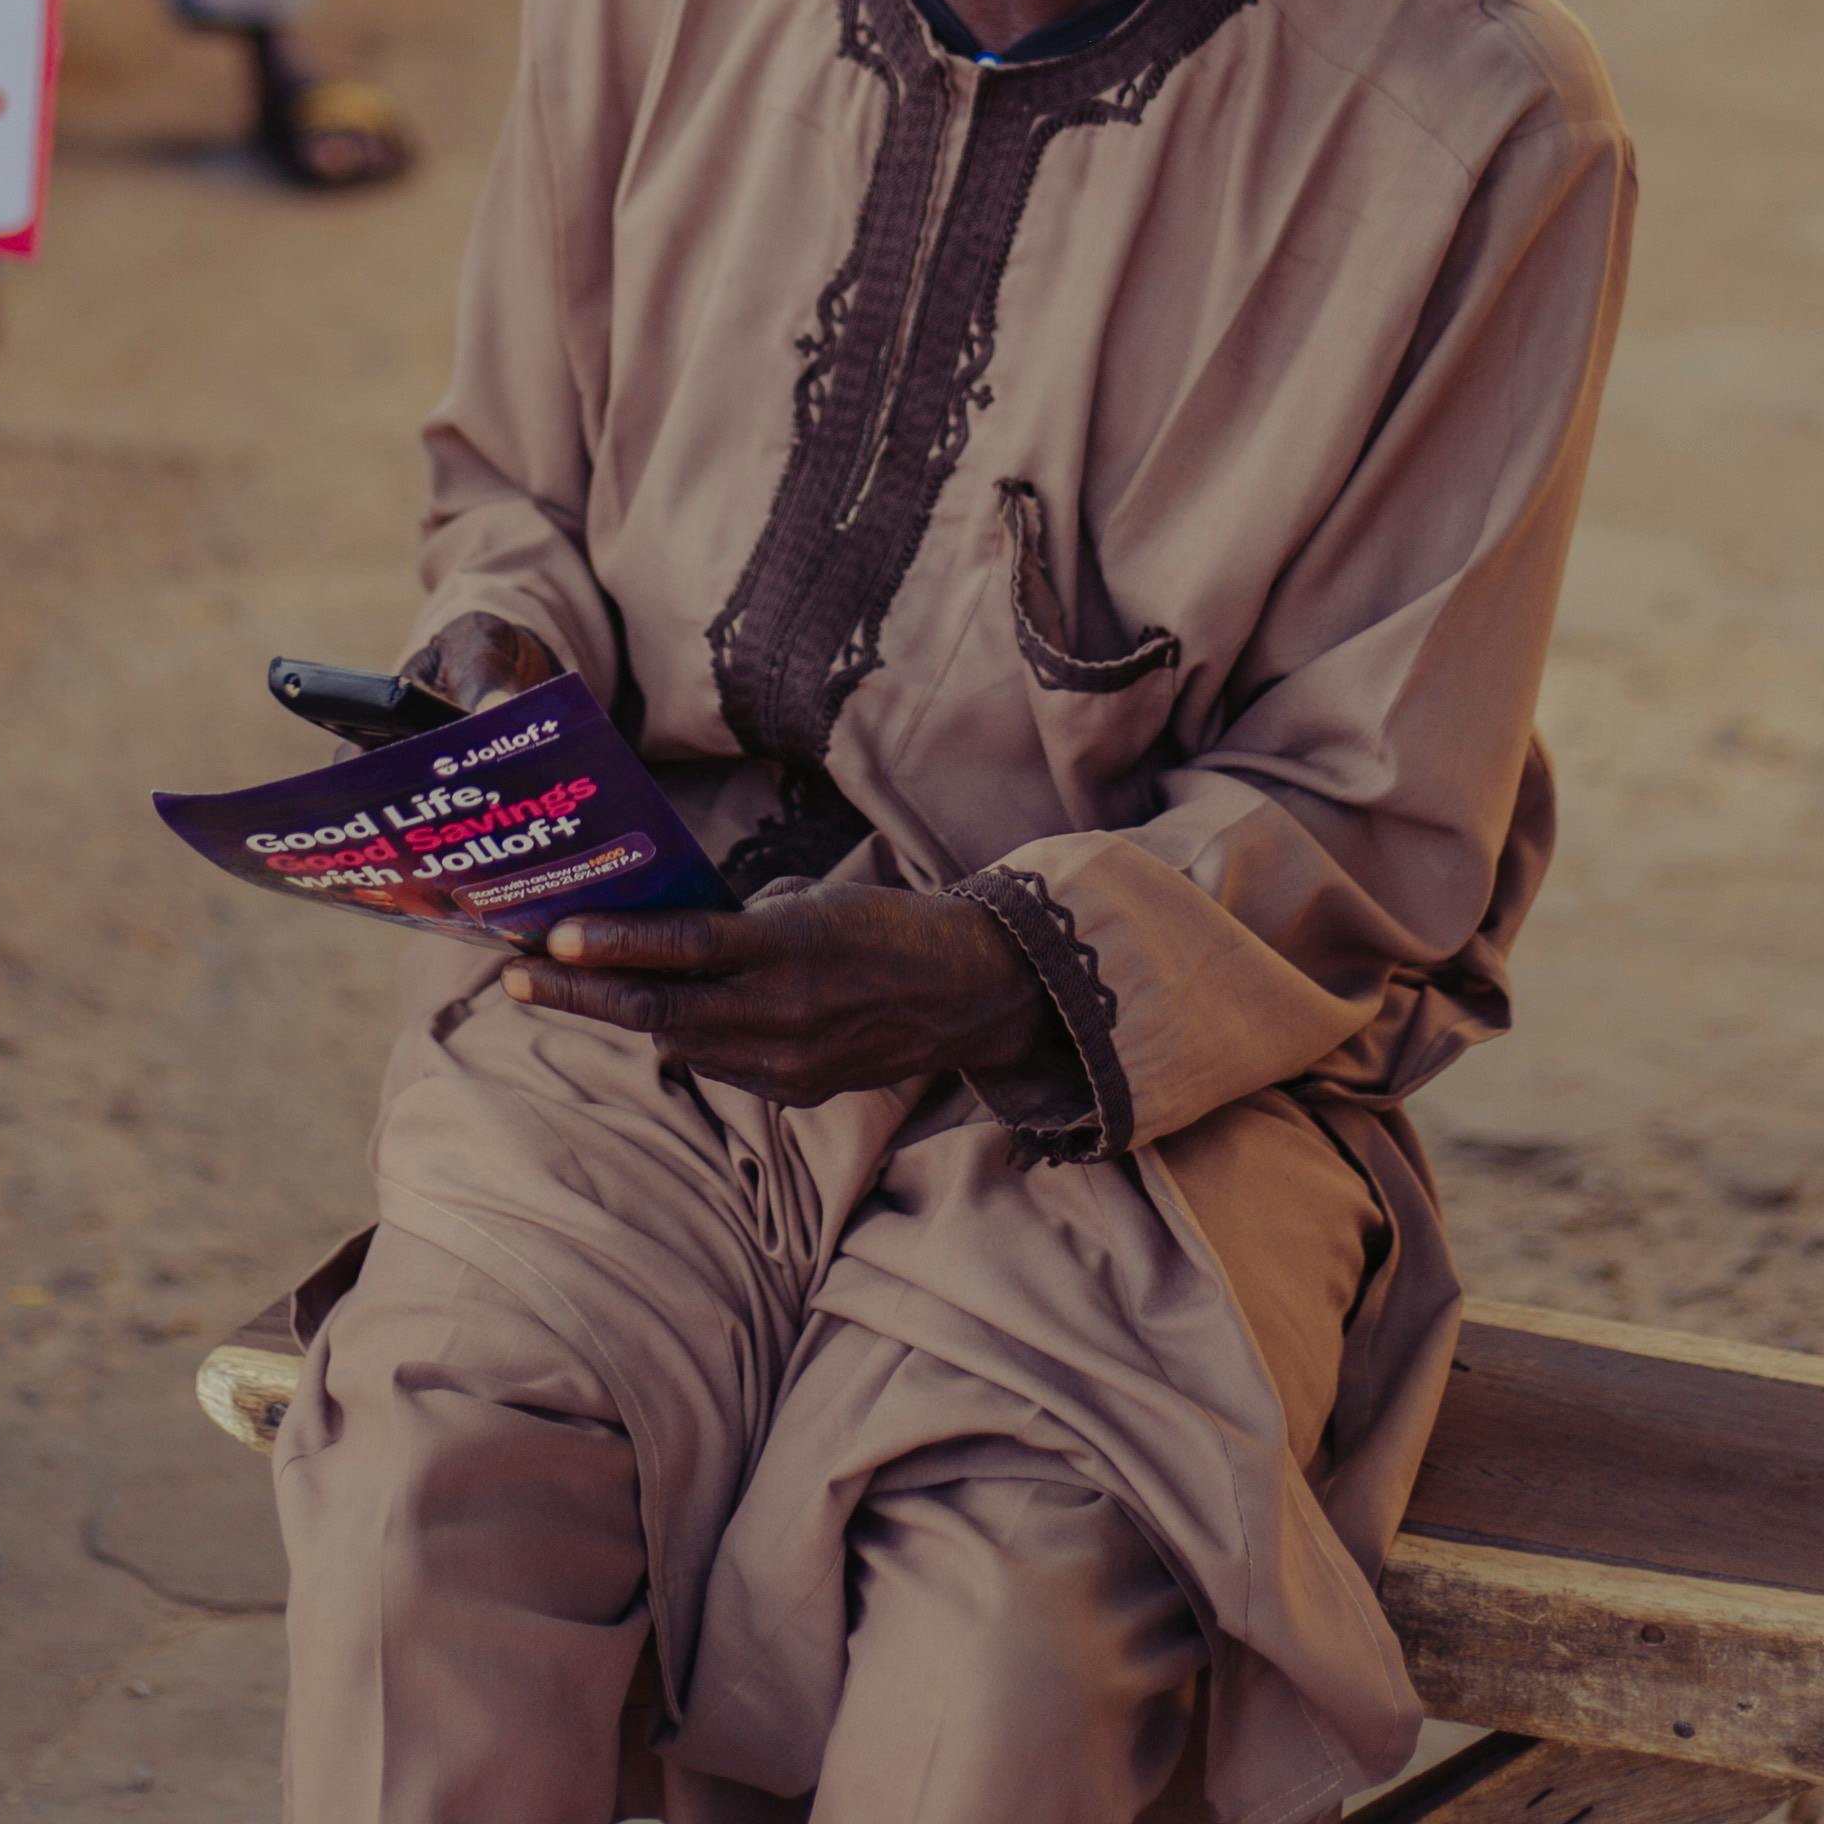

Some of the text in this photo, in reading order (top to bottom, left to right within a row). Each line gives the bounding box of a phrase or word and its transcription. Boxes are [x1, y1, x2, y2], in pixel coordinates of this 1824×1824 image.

[462, 720, 558, 768] Jollof+
[246, 787, 500, 853] Good Life,
[266, 777, 597, 872] Good Savings
[285, 816, 581, 889] with Jollof+
[468, 886, 501, 899] Start
[501, 878, 529, 893] with
[530, 873, 547, 885] as
[547, 867, 571, 880] low
[572, 861, 589, 874] as
[474, 897, 489, 906] to
[489, 888, 525, 902] enjoy
[526, 883, 545, 895] up
[545, 878, 559, 888] to
[595, 859, 619, 874] NET
